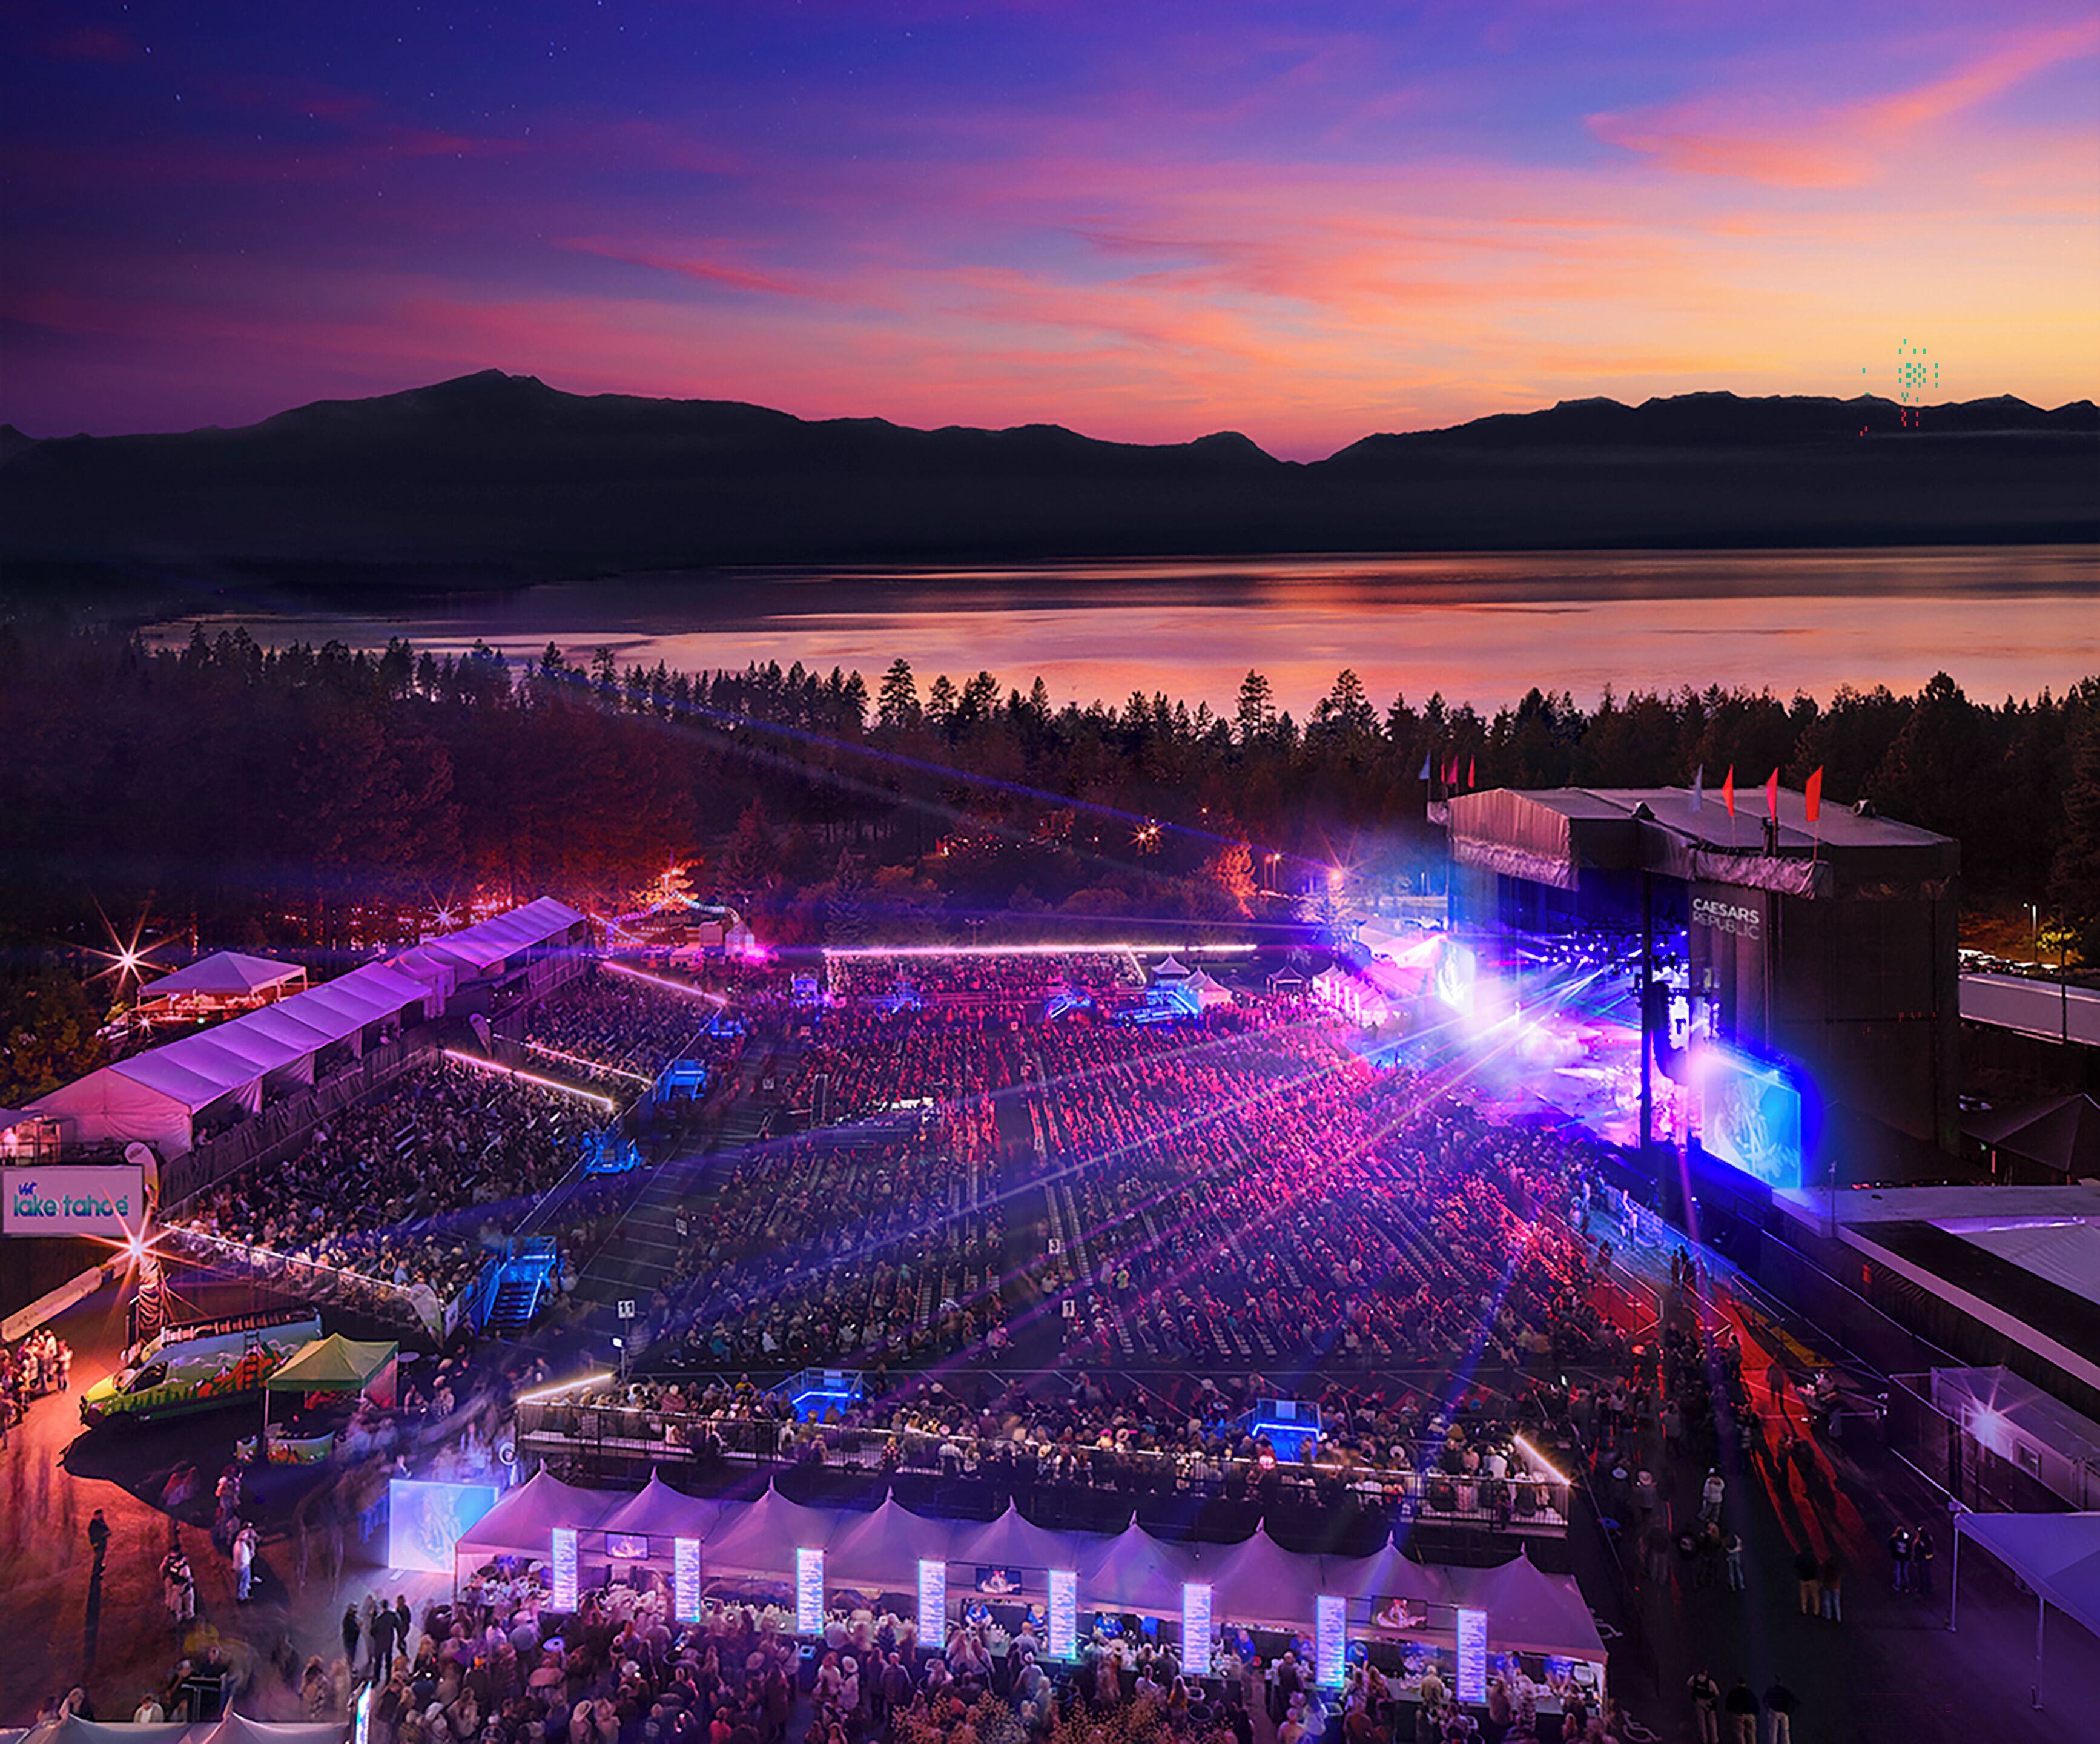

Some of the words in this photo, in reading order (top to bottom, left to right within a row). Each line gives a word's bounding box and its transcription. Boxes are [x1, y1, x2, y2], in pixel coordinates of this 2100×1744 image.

[1692, 897, 1760, 925] CAESARS
[1692, 911, 1760, 940] REPUBLIC
[13, 1194, 58, 1217] lake
[62, 1194, 128, 1217] tahoe
[1051, 1240, 1058, 1251] 3
[619, 1301, 633, 1313] 11
